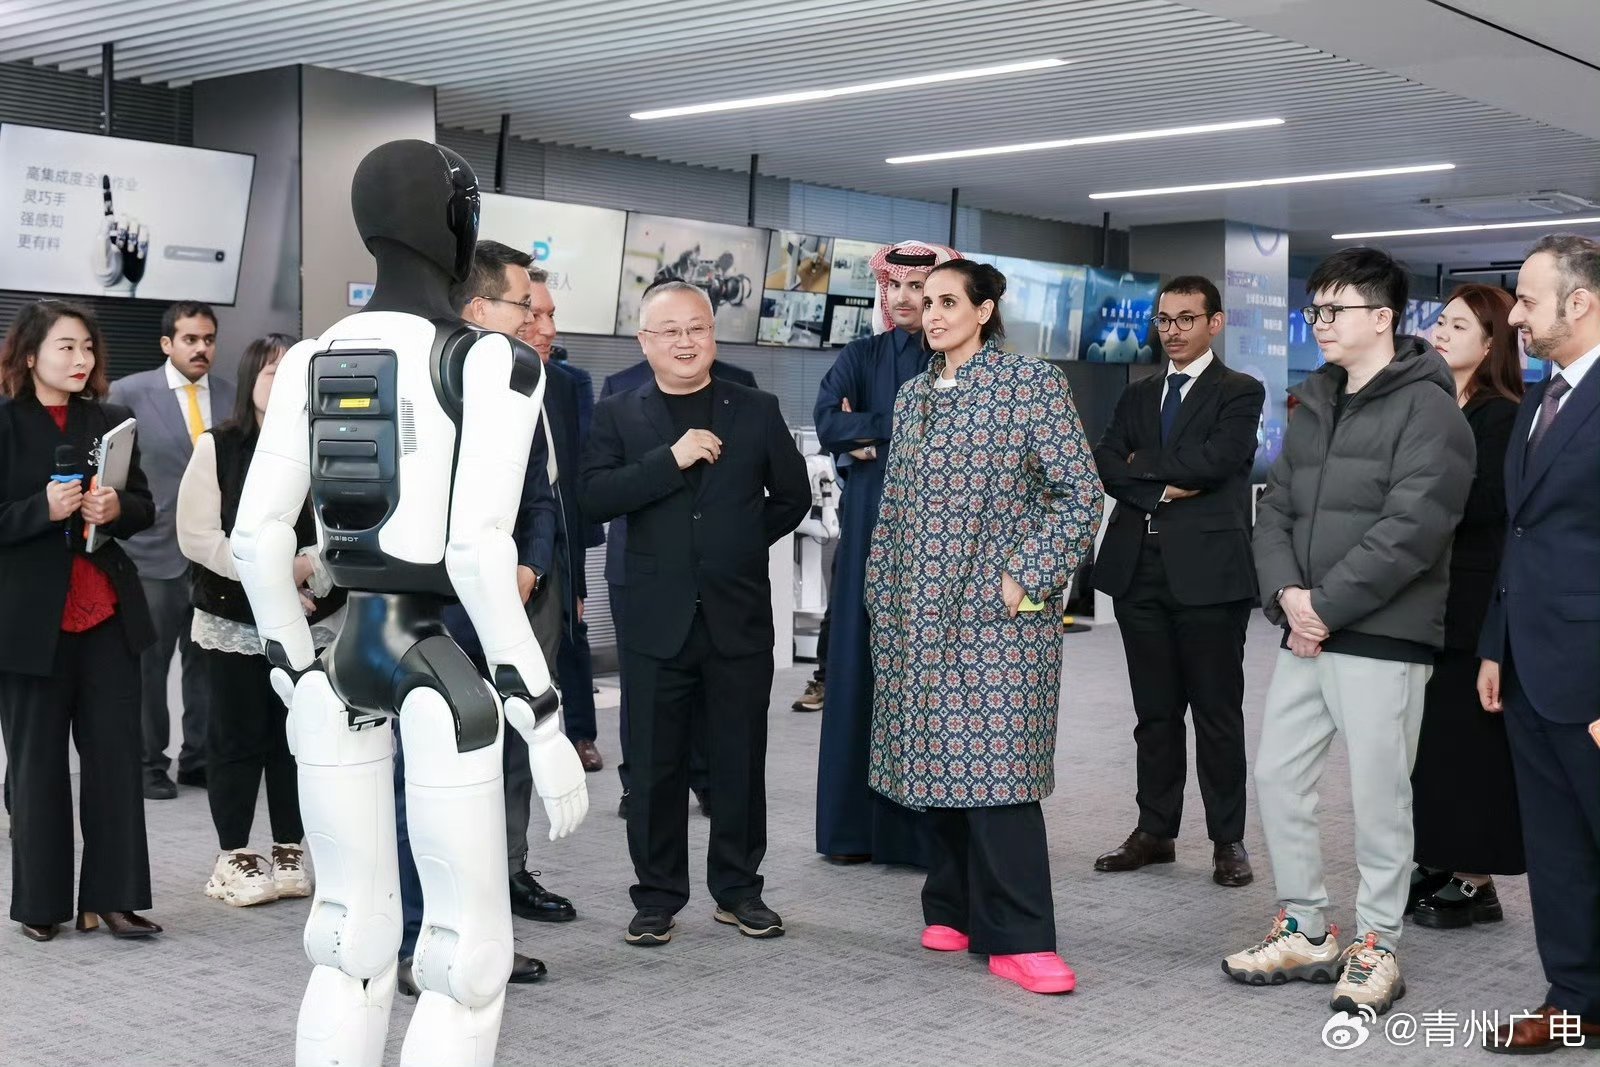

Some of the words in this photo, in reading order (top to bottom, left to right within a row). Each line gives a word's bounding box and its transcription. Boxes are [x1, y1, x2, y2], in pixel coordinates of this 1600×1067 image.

[23, 188, 66, 206] 灵巧手
[20, 211, 64, 228] 强感知
[17, 233, 61, 251] 更有料
